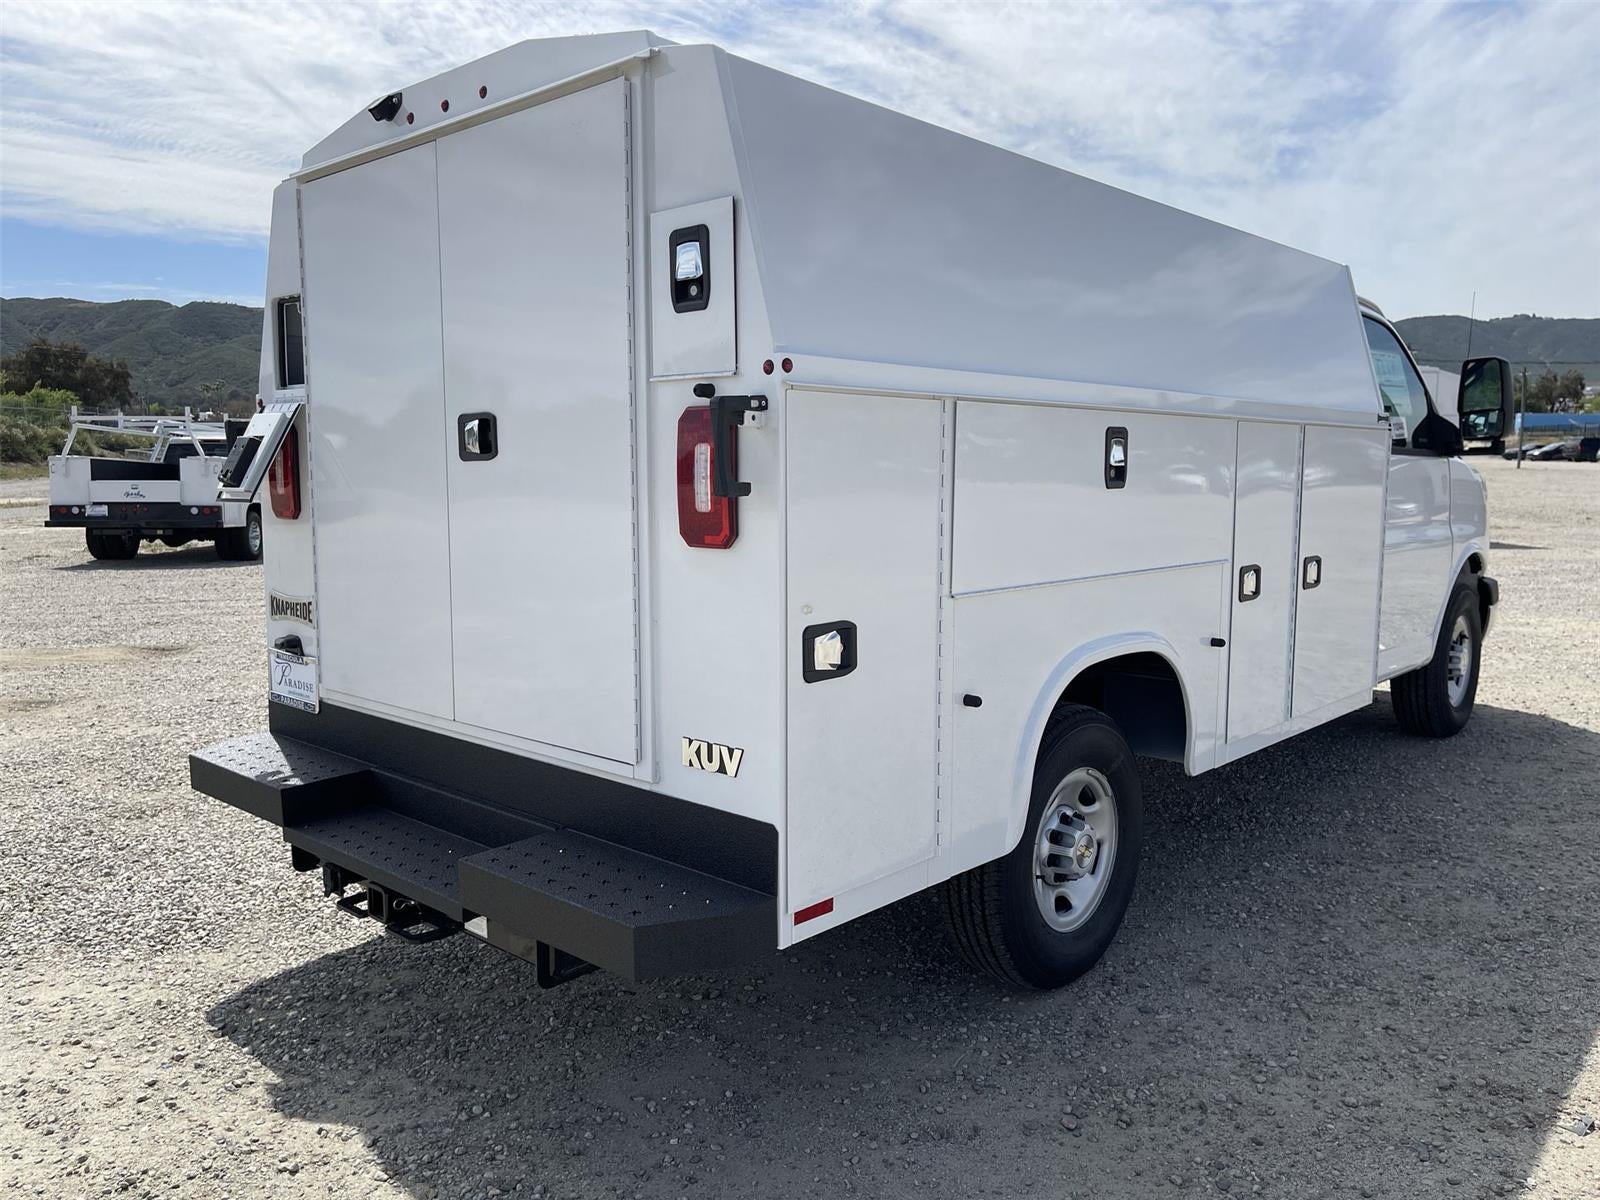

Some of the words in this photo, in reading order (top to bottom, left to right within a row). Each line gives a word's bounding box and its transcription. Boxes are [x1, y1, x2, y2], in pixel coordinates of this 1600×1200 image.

[270, 595, 313, 624] KNAPHEIDE
[274, 659, 314, 692] PARADISE
[682, 736, 744, 778] KUV
